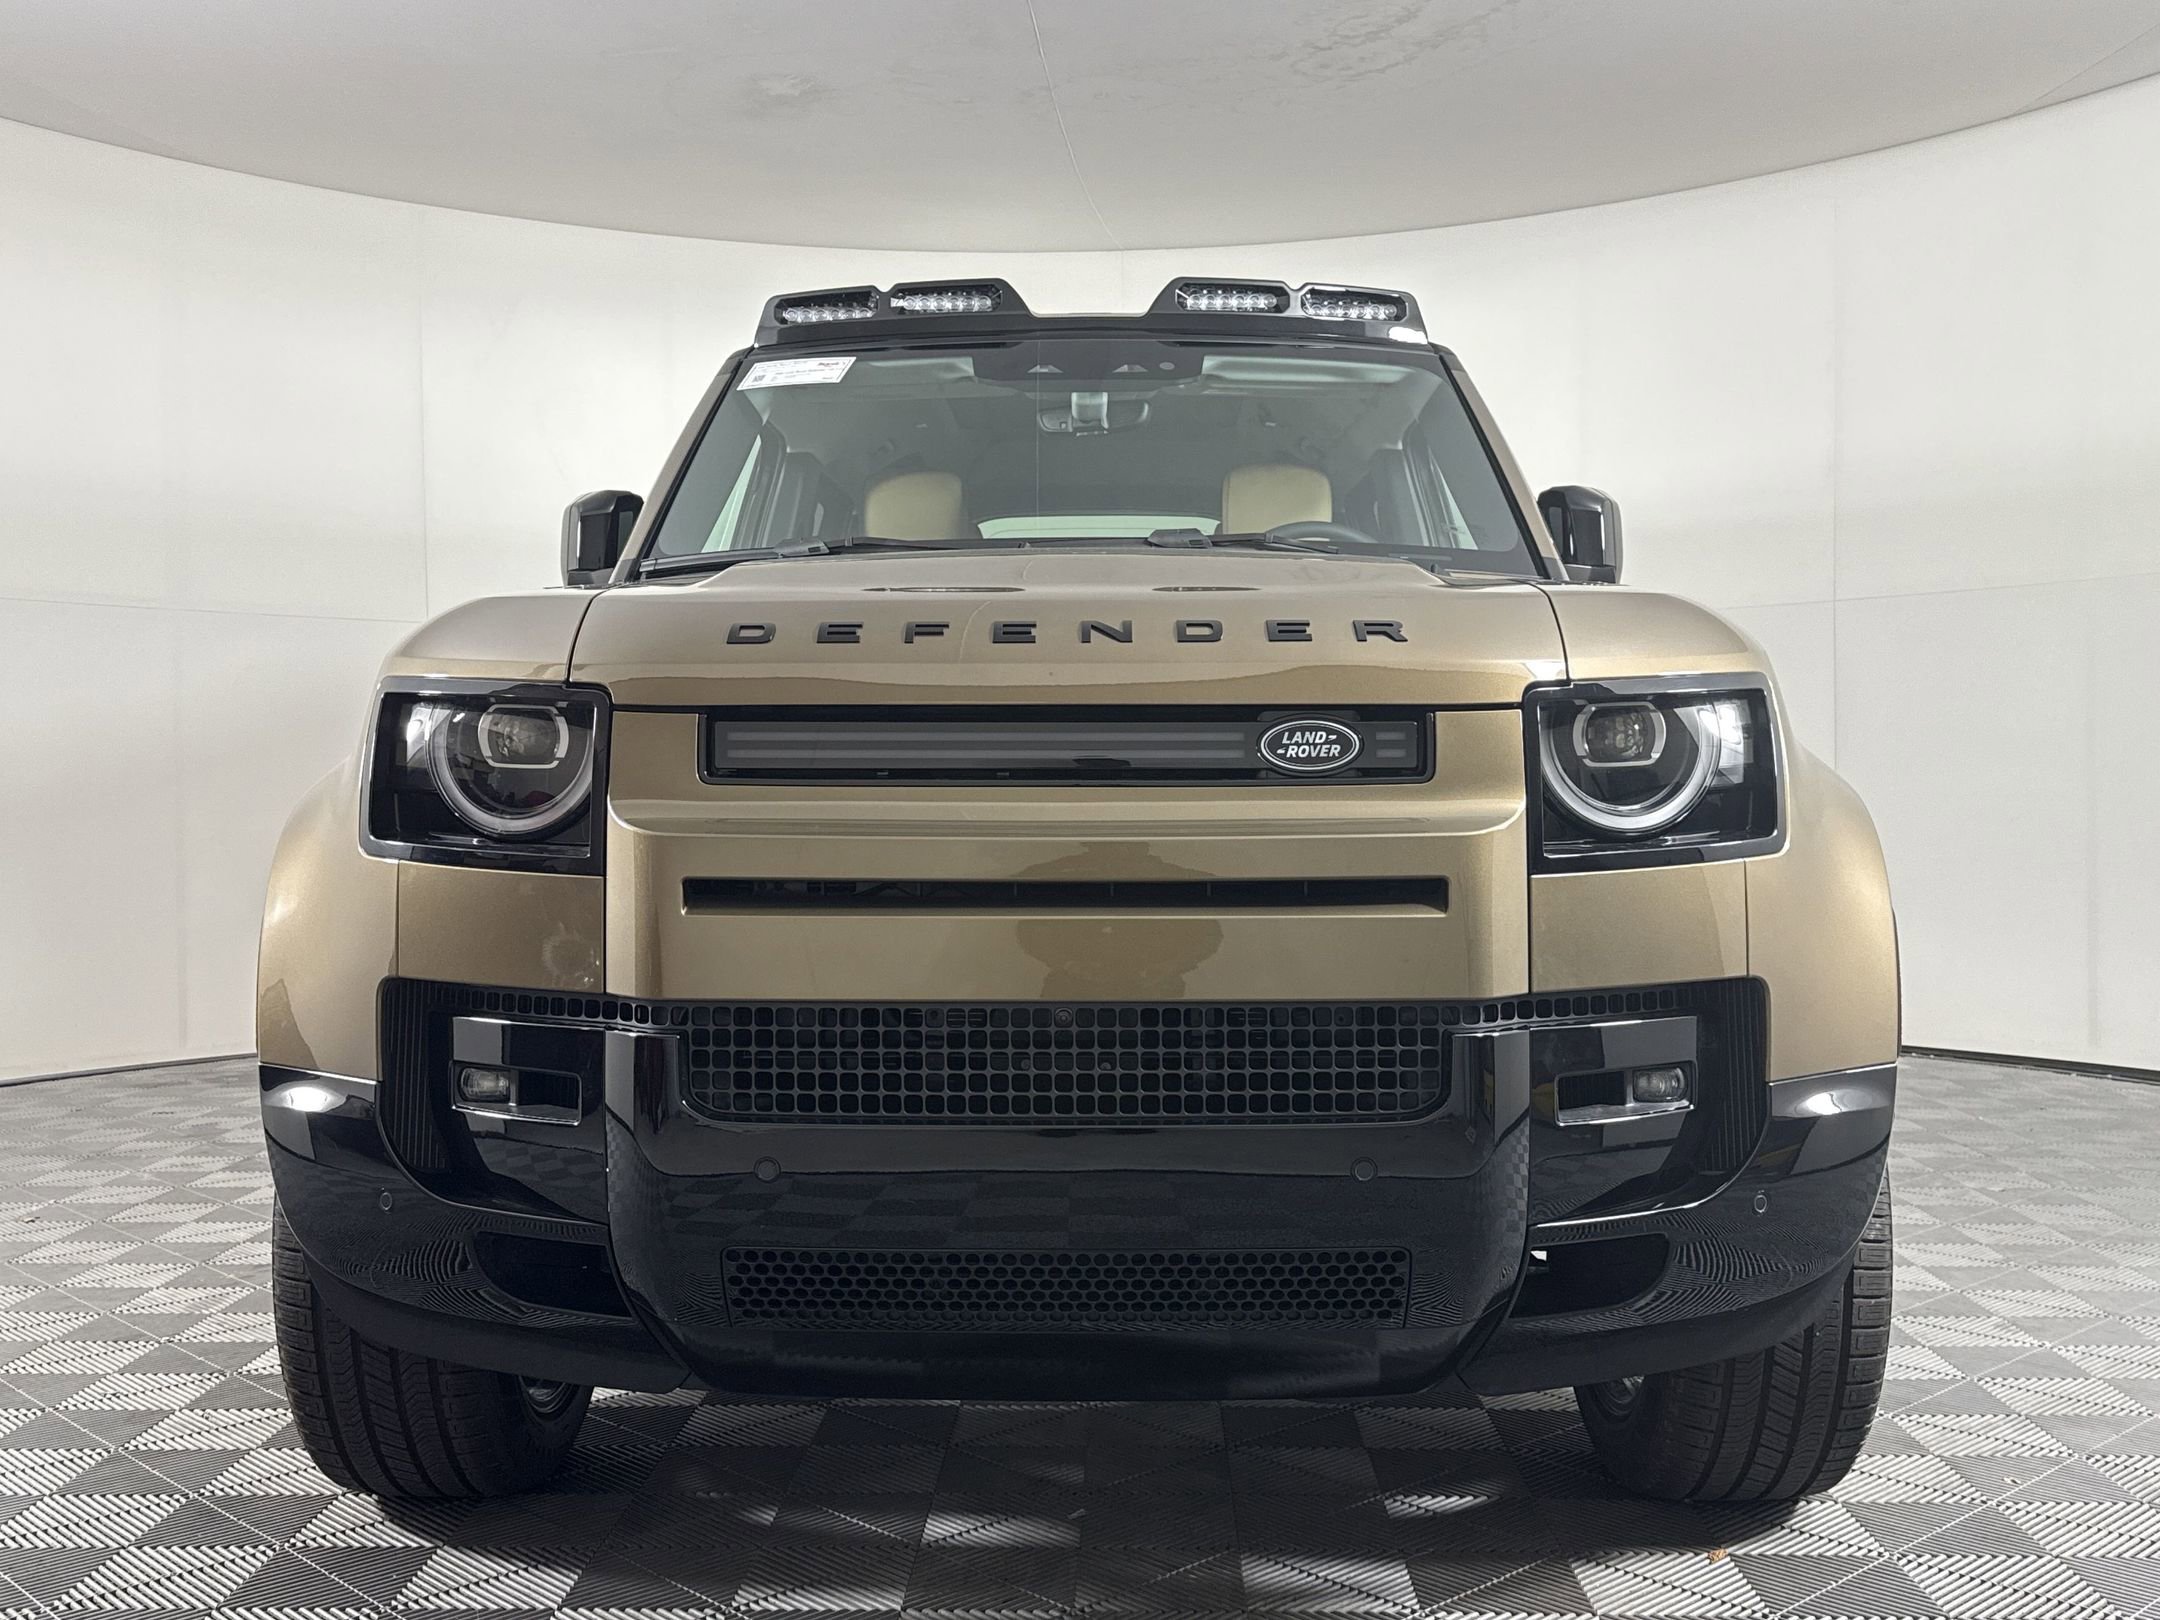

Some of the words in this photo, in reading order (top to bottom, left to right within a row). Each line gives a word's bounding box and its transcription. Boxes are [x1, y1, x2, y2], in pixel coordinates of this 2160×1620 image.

[726, 619, 1408, 645] DEFENDER
[1282, 731, 1327, 744] LAND
[1286, 744, 1341, 758] ROVER
